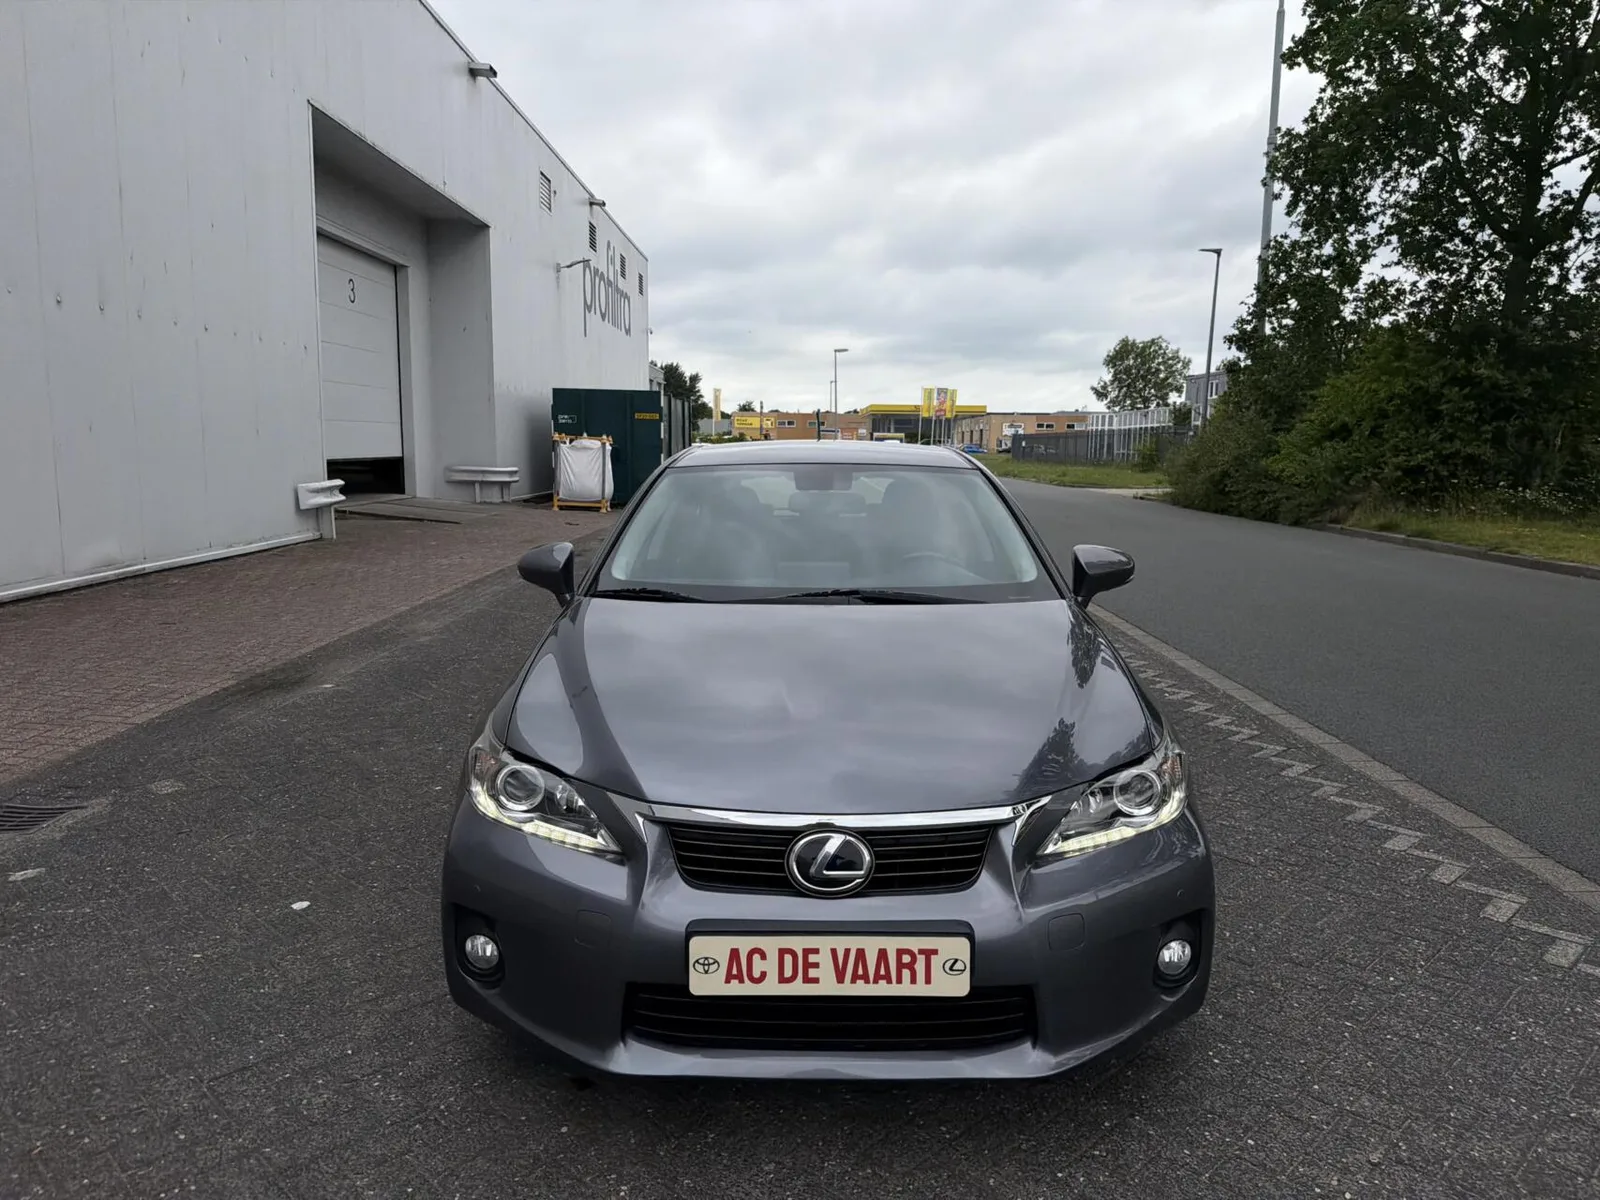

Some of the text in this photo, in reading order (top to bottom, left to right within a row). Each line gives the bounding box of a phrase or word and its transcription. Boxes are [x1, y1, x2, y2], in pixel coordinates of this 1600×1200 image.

[347, 278, 356, 304] 3
[582, 240, 631, 338] profiltra
[724, 947, 939, 985] AC DE VAART
